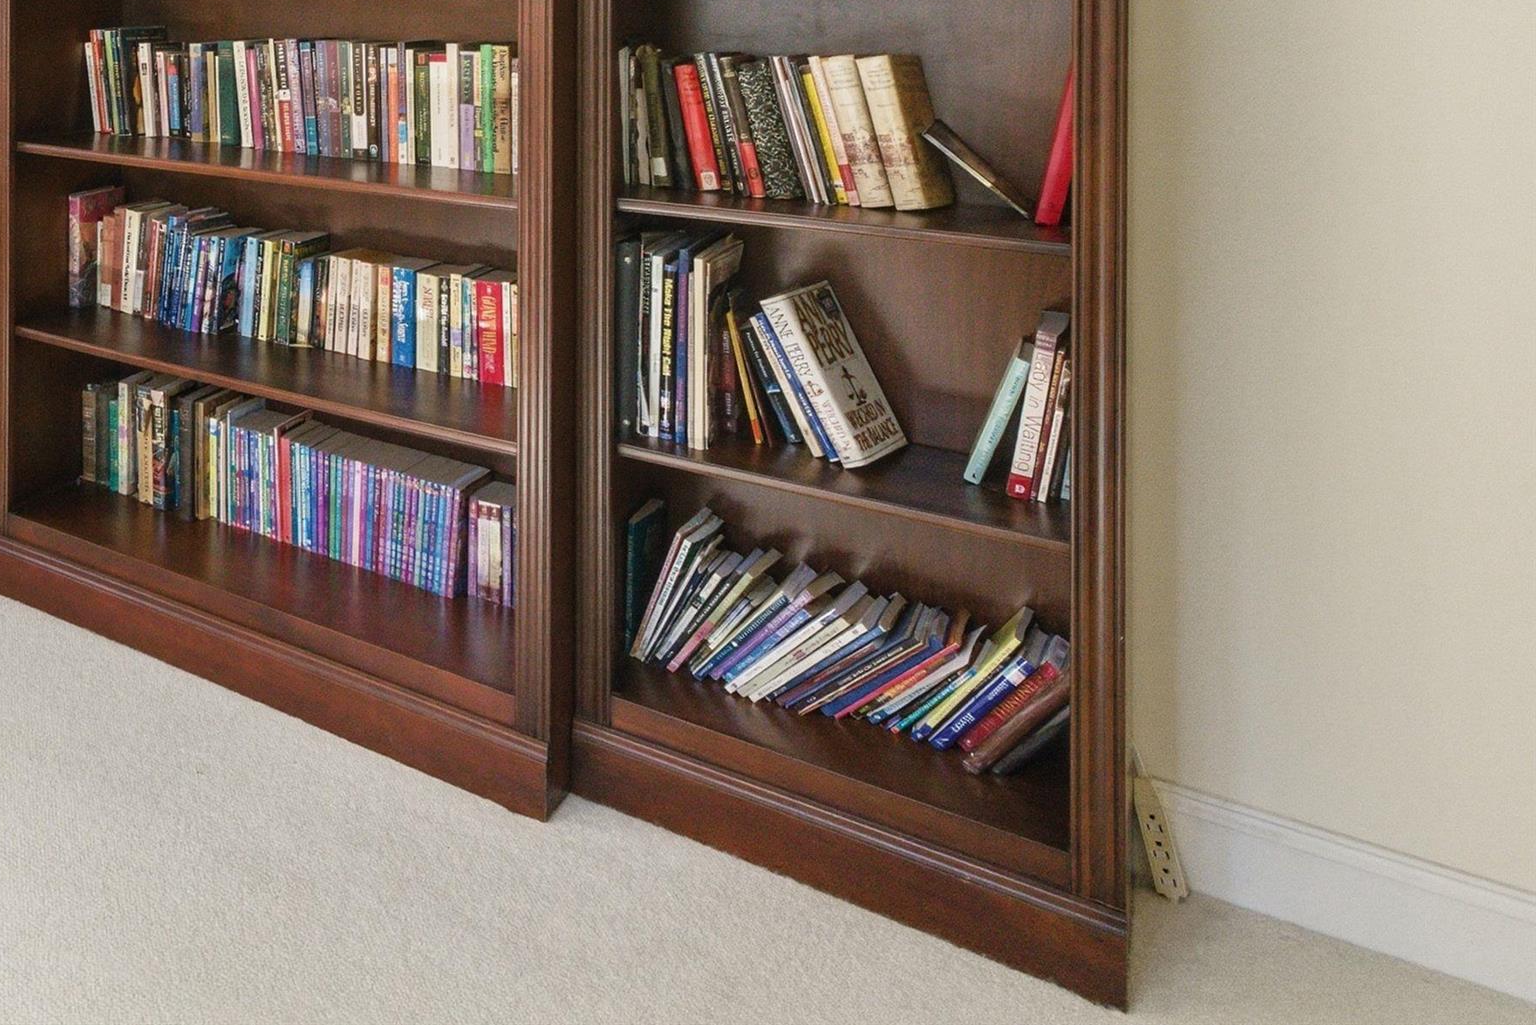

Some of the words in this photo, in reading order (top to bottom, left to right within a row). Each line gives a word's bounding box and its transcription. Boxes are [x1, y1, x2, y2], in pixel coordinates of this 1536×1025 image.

[663, 278, 673, 305] Make
[480, 295, 496, 321] GONE
[663, 307, 673, 325] The
[662, 327, 672, 355] Right
[768, 307, 793, 339] ANNE
[788, 343, 813, 377] PERRY
[808, 319, 854, 367] PERRY
[662, 356, 672, 376] Call
[1029, 352, 1052, 390] Lady
[1030, 397, 1042, 409] in
[1015, 416, 1041, 472] Waiting
